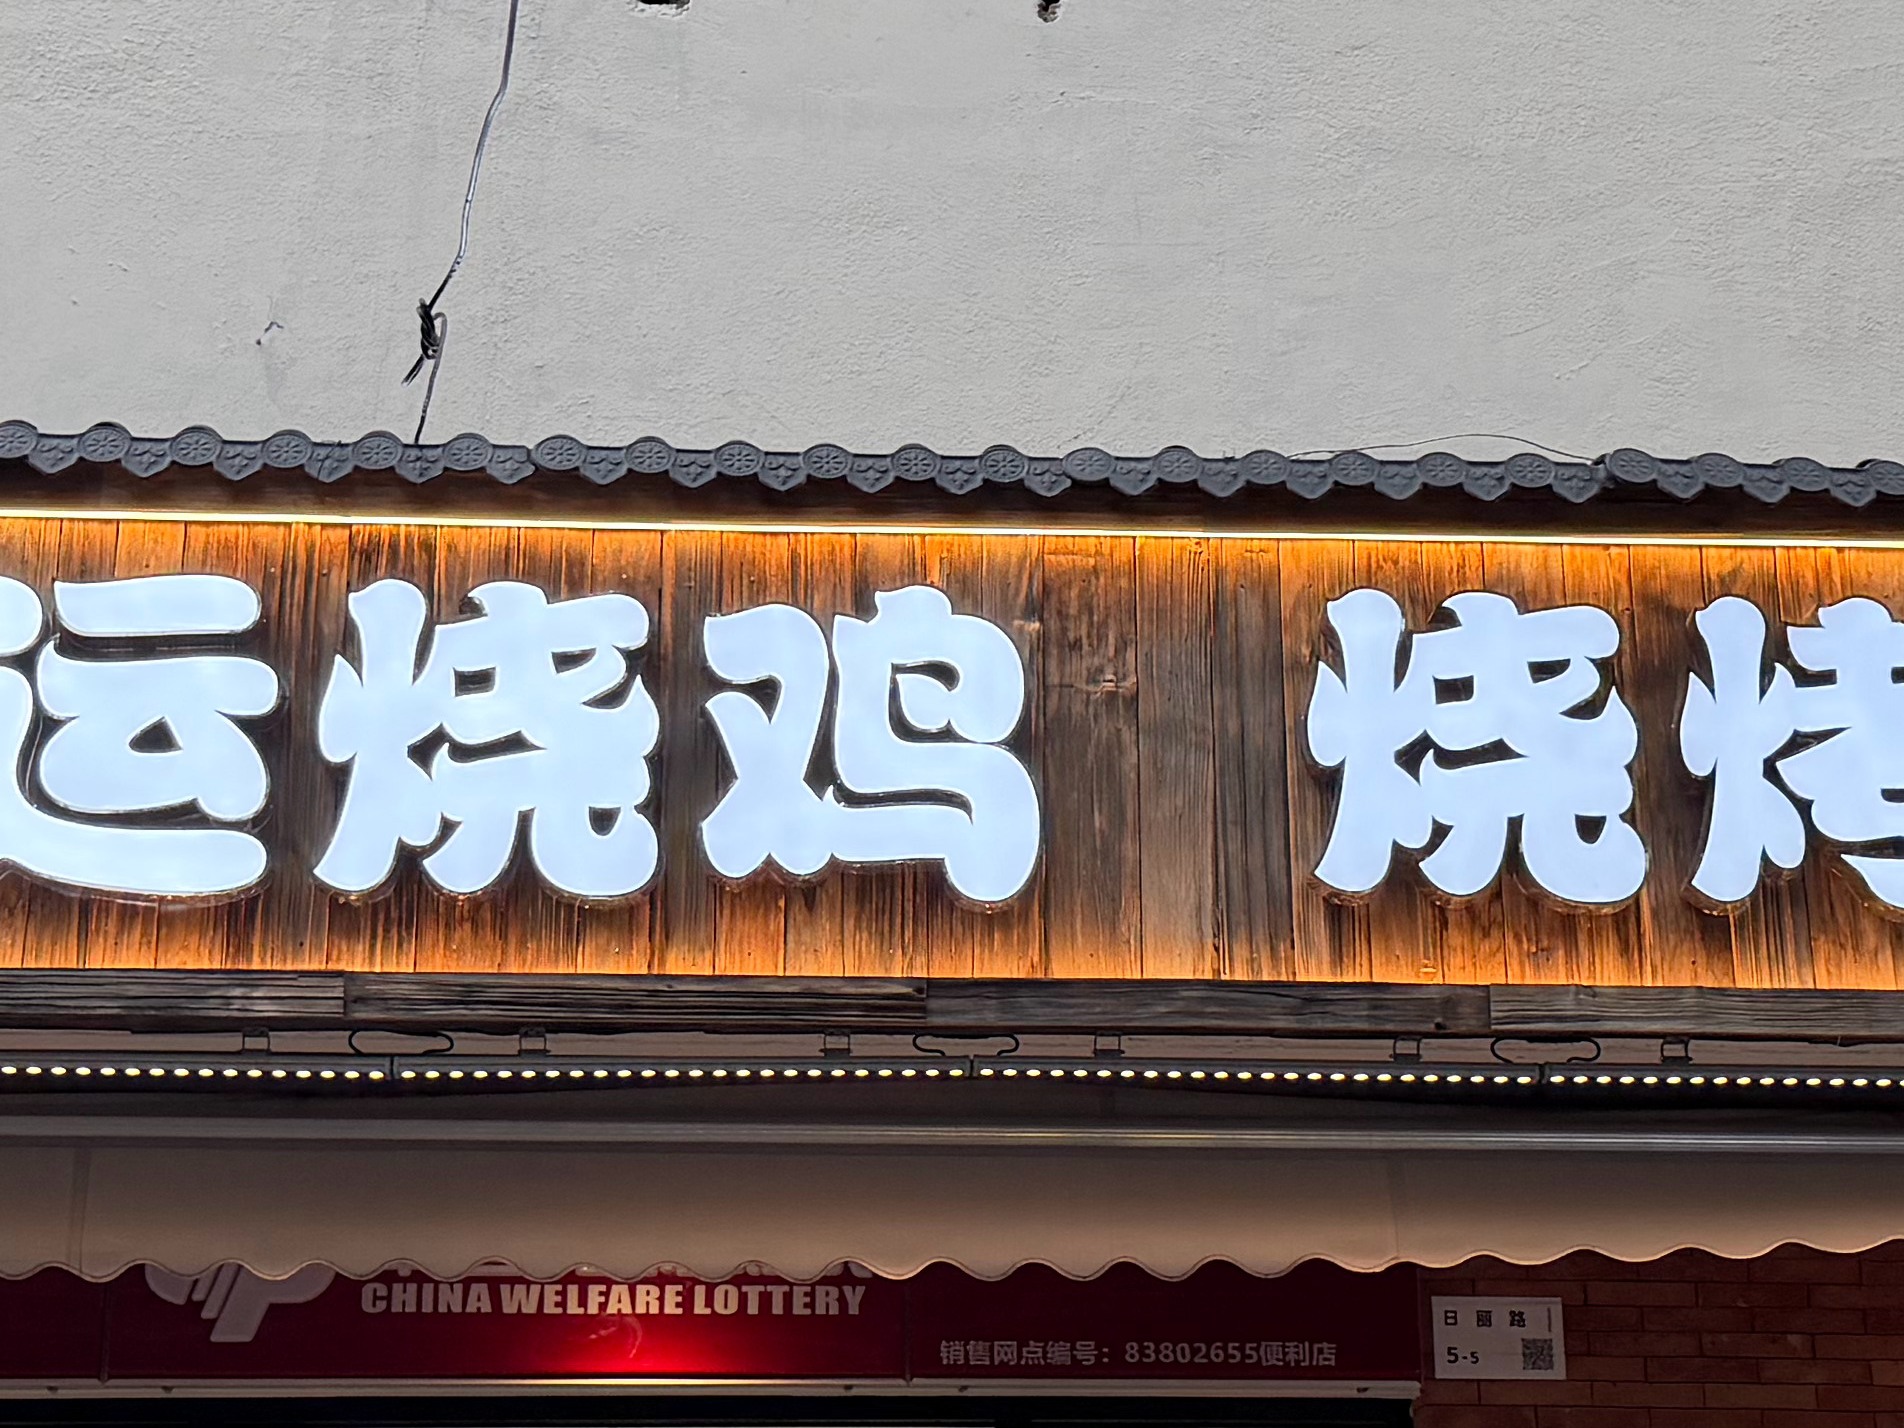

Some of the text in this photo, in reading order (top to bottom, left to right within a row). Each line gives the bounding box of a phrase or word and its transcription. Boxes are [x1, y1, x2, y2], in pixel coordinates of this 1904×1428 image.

[361, 1282, 866, 1315] CHINA WELFARE LOTTERY
